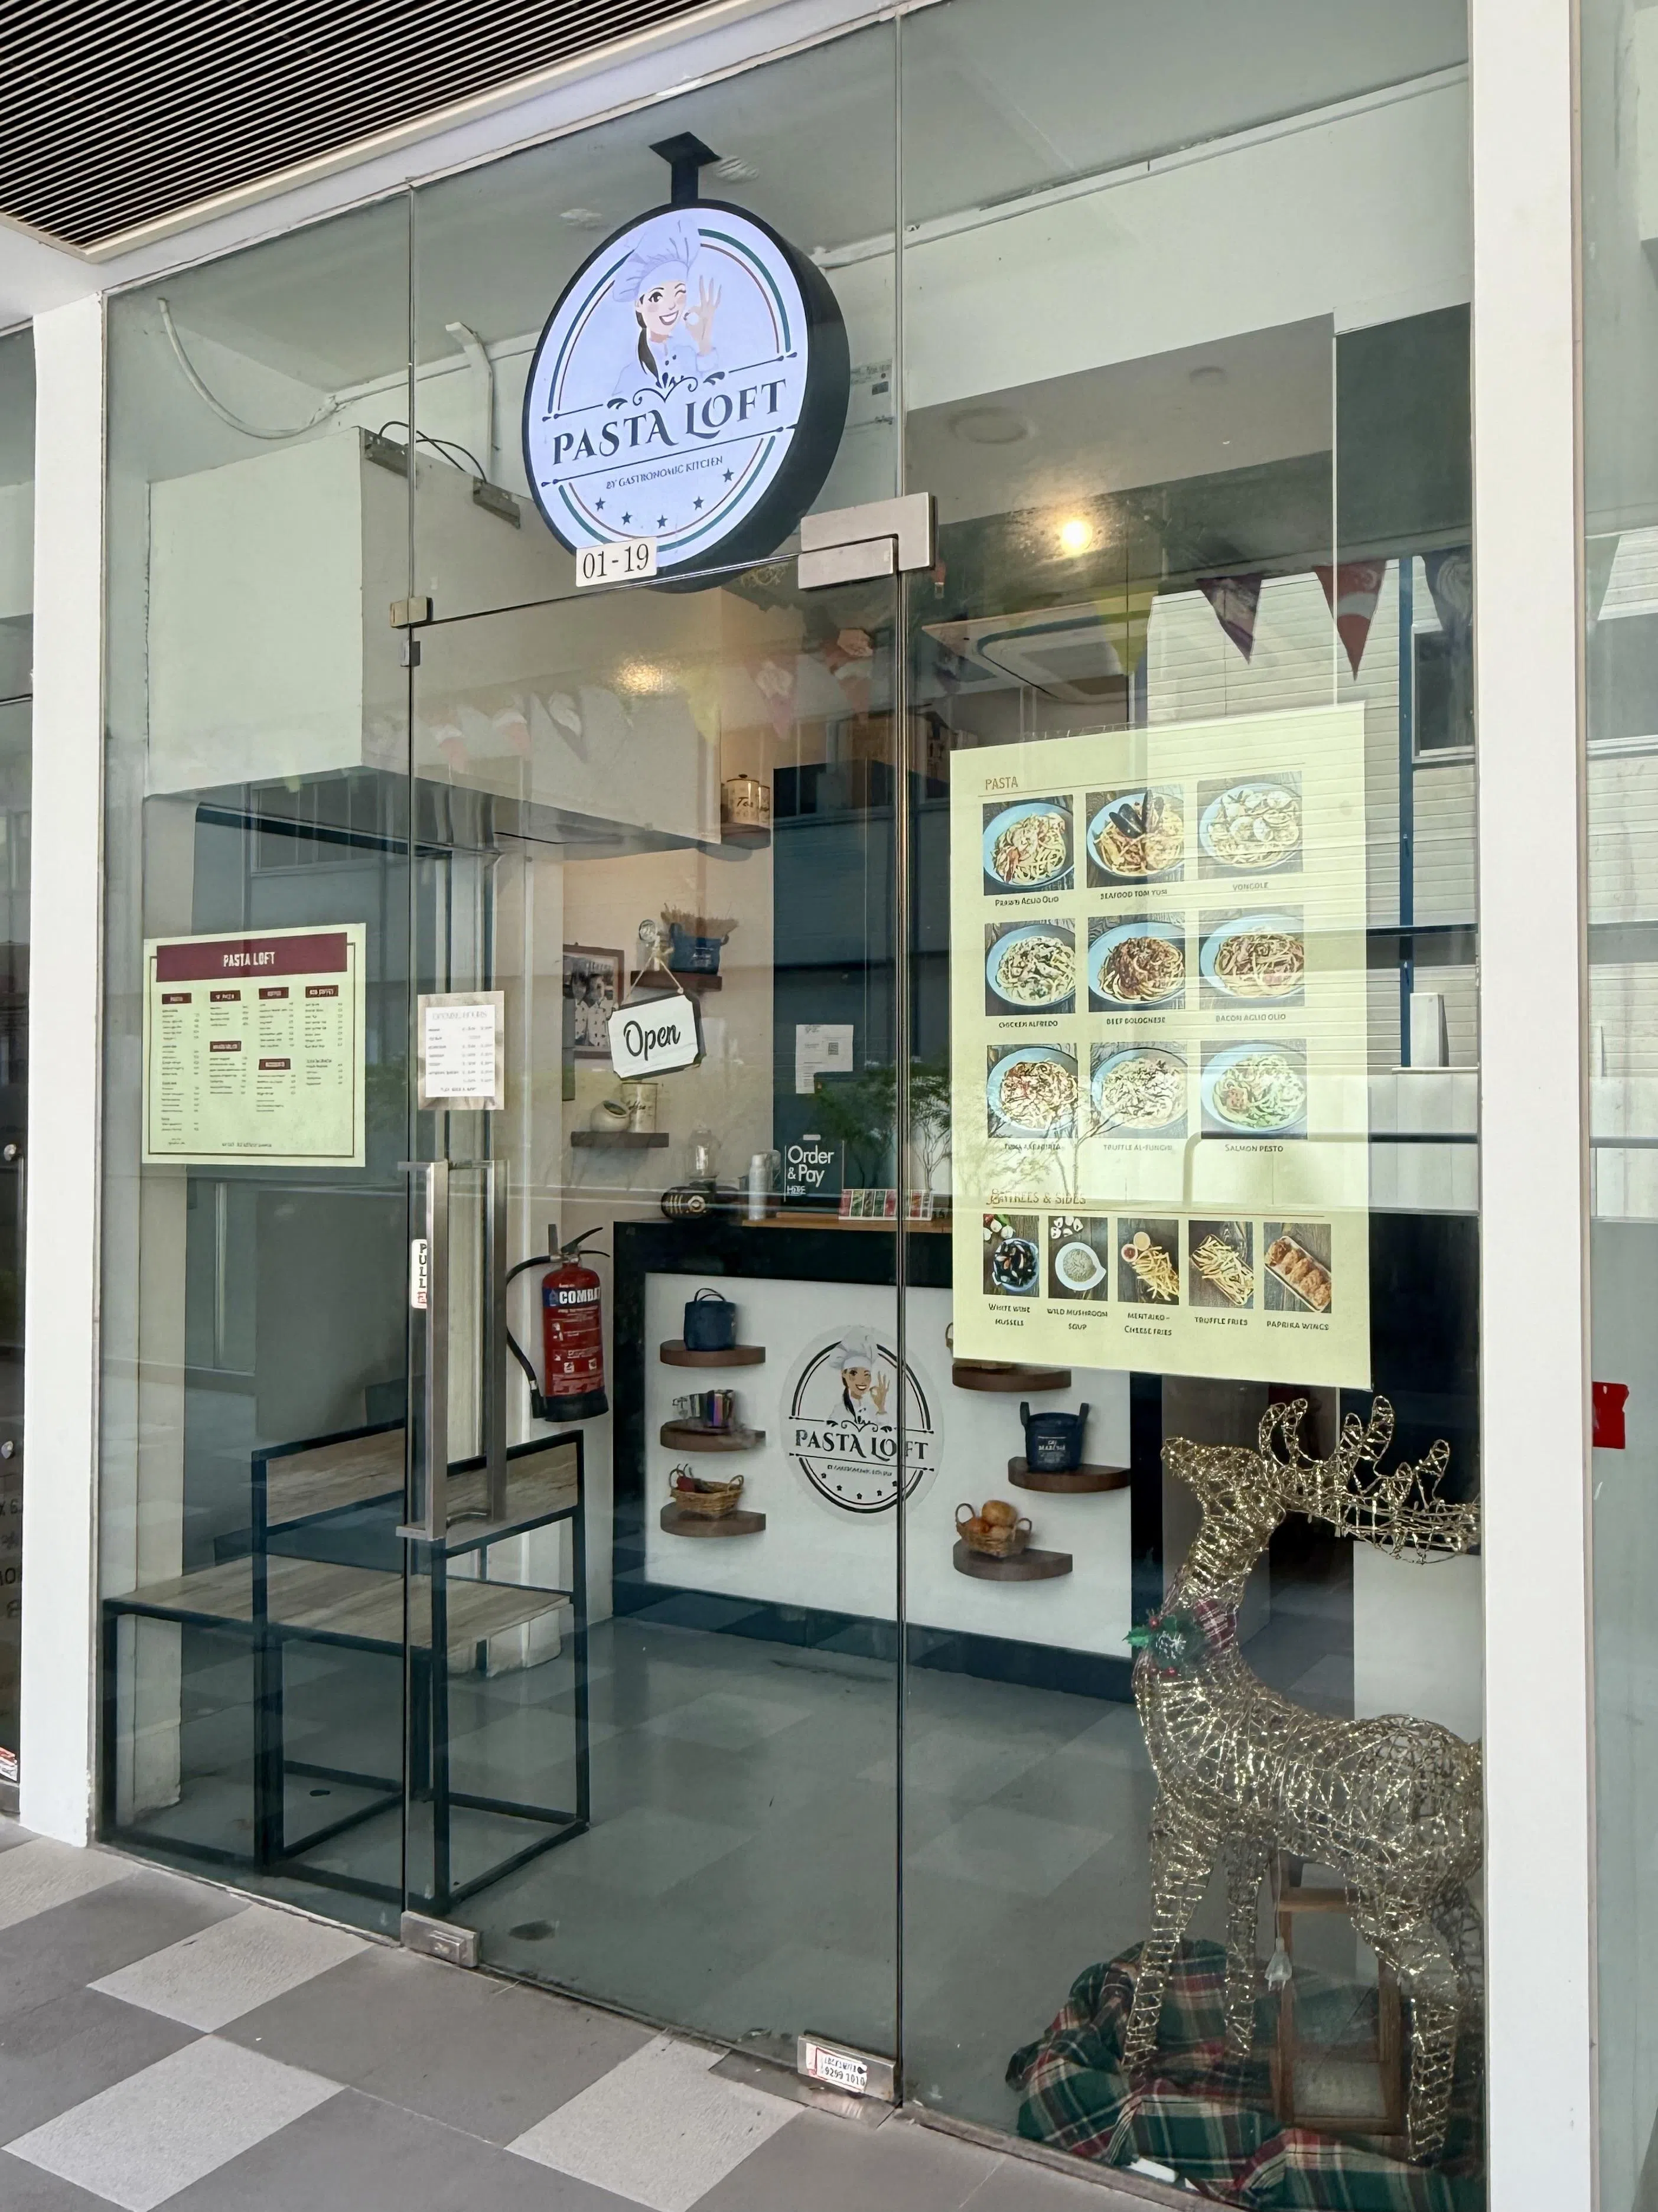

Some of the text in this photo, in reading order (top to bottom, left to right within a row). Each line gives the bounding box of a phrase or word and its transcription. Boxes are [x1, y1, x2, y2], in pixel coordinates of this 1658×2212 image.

[552, 379, 787, 465] PASTA LOFT
[582, 543, 650, 579] 01-19
[985, 776, 1018, 791] PASTA
[223, 952, 275, 967] PASTA LOFT
[623, 1020, 681, 1061] Open
[787, 1144, 835, 1165] Order
[1224, 1144, 1258, 1152] SALMON
[787, 1163, 825, 1188] & Pay
[418, 1243, 427, 1289] PULL
[1194, 1317, 1248, 1326] TRUFFLE FRIES
[1266, 1320, 1300, 1329] PAPRIKA
[795, 1429, 929, 1462] PASTA LOFT
